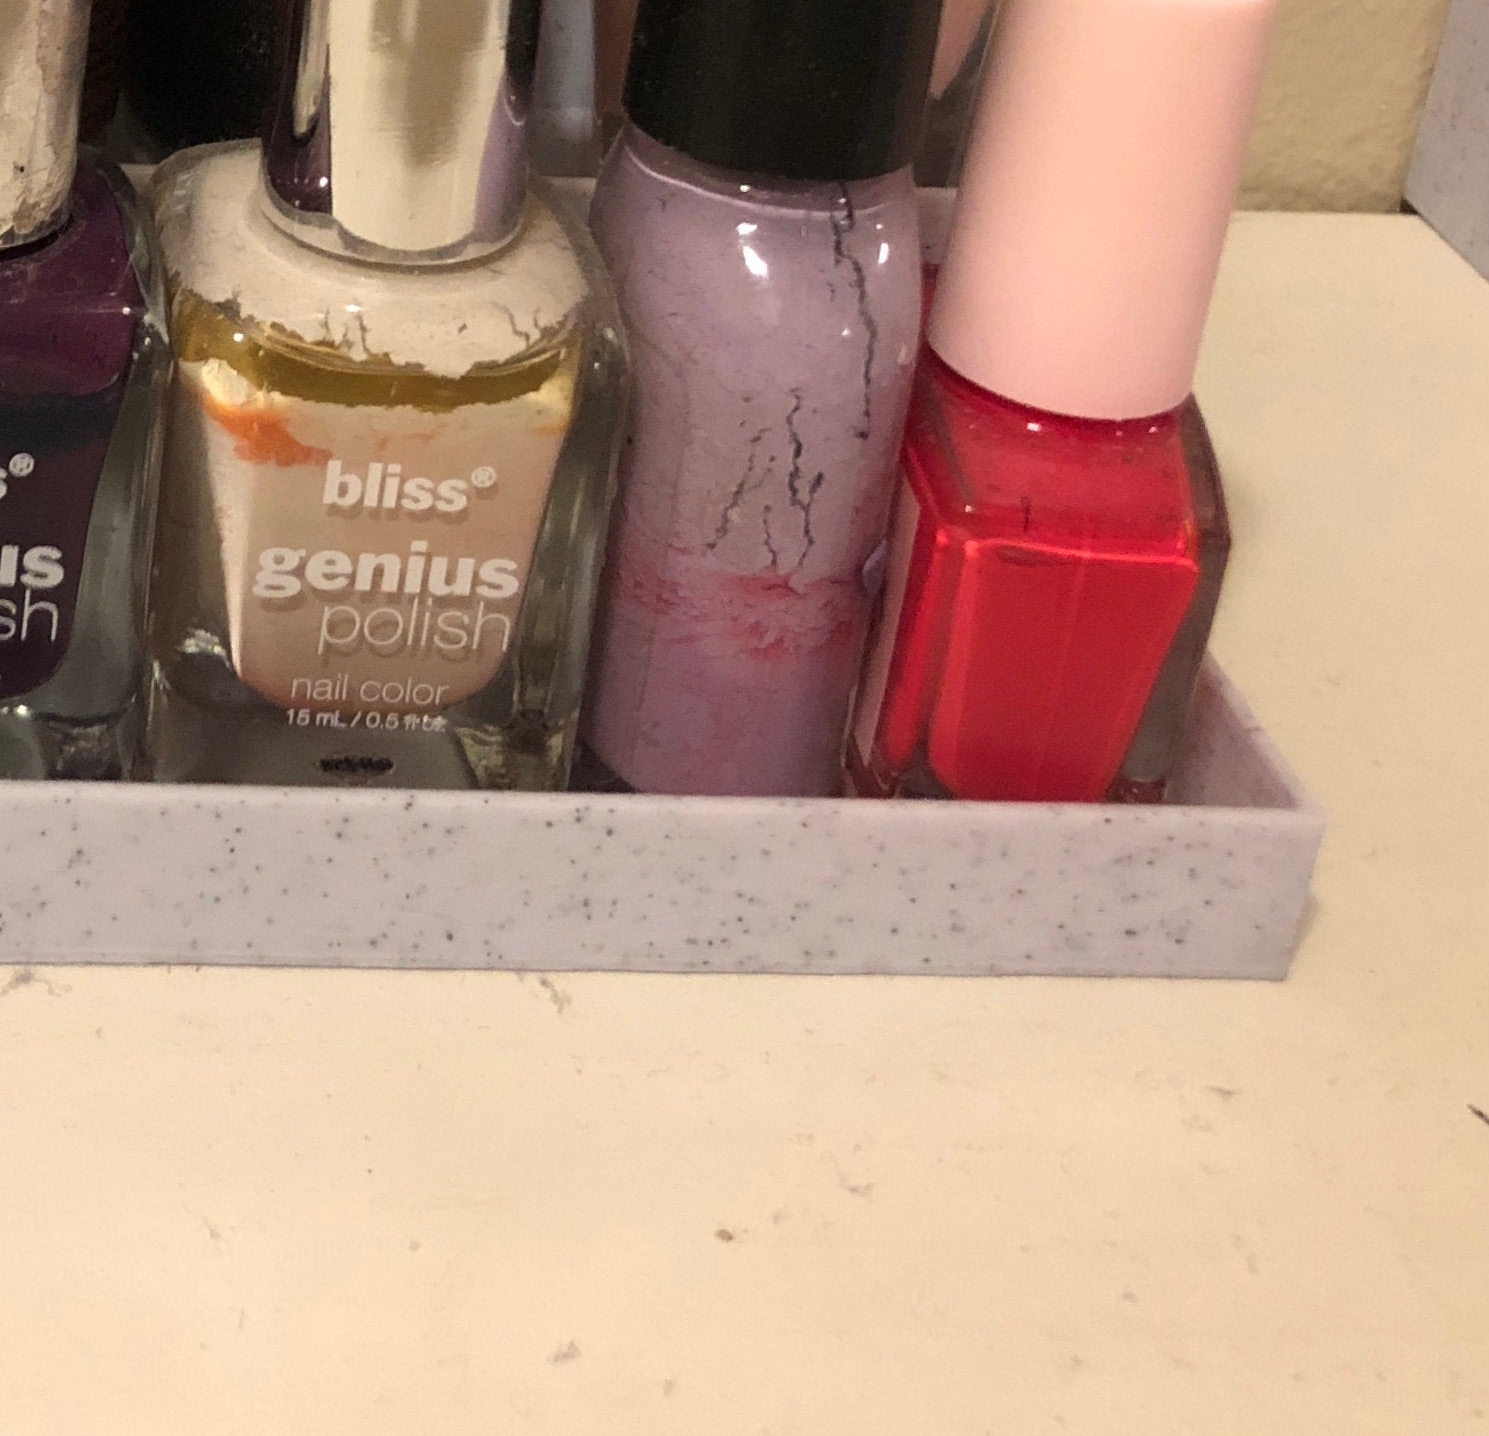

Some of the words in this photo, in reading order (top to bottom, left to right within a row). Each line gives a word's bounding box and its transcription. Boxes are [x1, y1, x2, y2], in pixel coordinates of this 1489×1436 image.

[252, 540, 520, 598] genius
[317, 596, 511, 656] polish
[291, 673, 350, 701] nail
[360, 676, 450, 706] color
[315, 709, 347, 729] mL
[349, 710, 363, 729] /
[366, 711, 400, 730] 0.5
